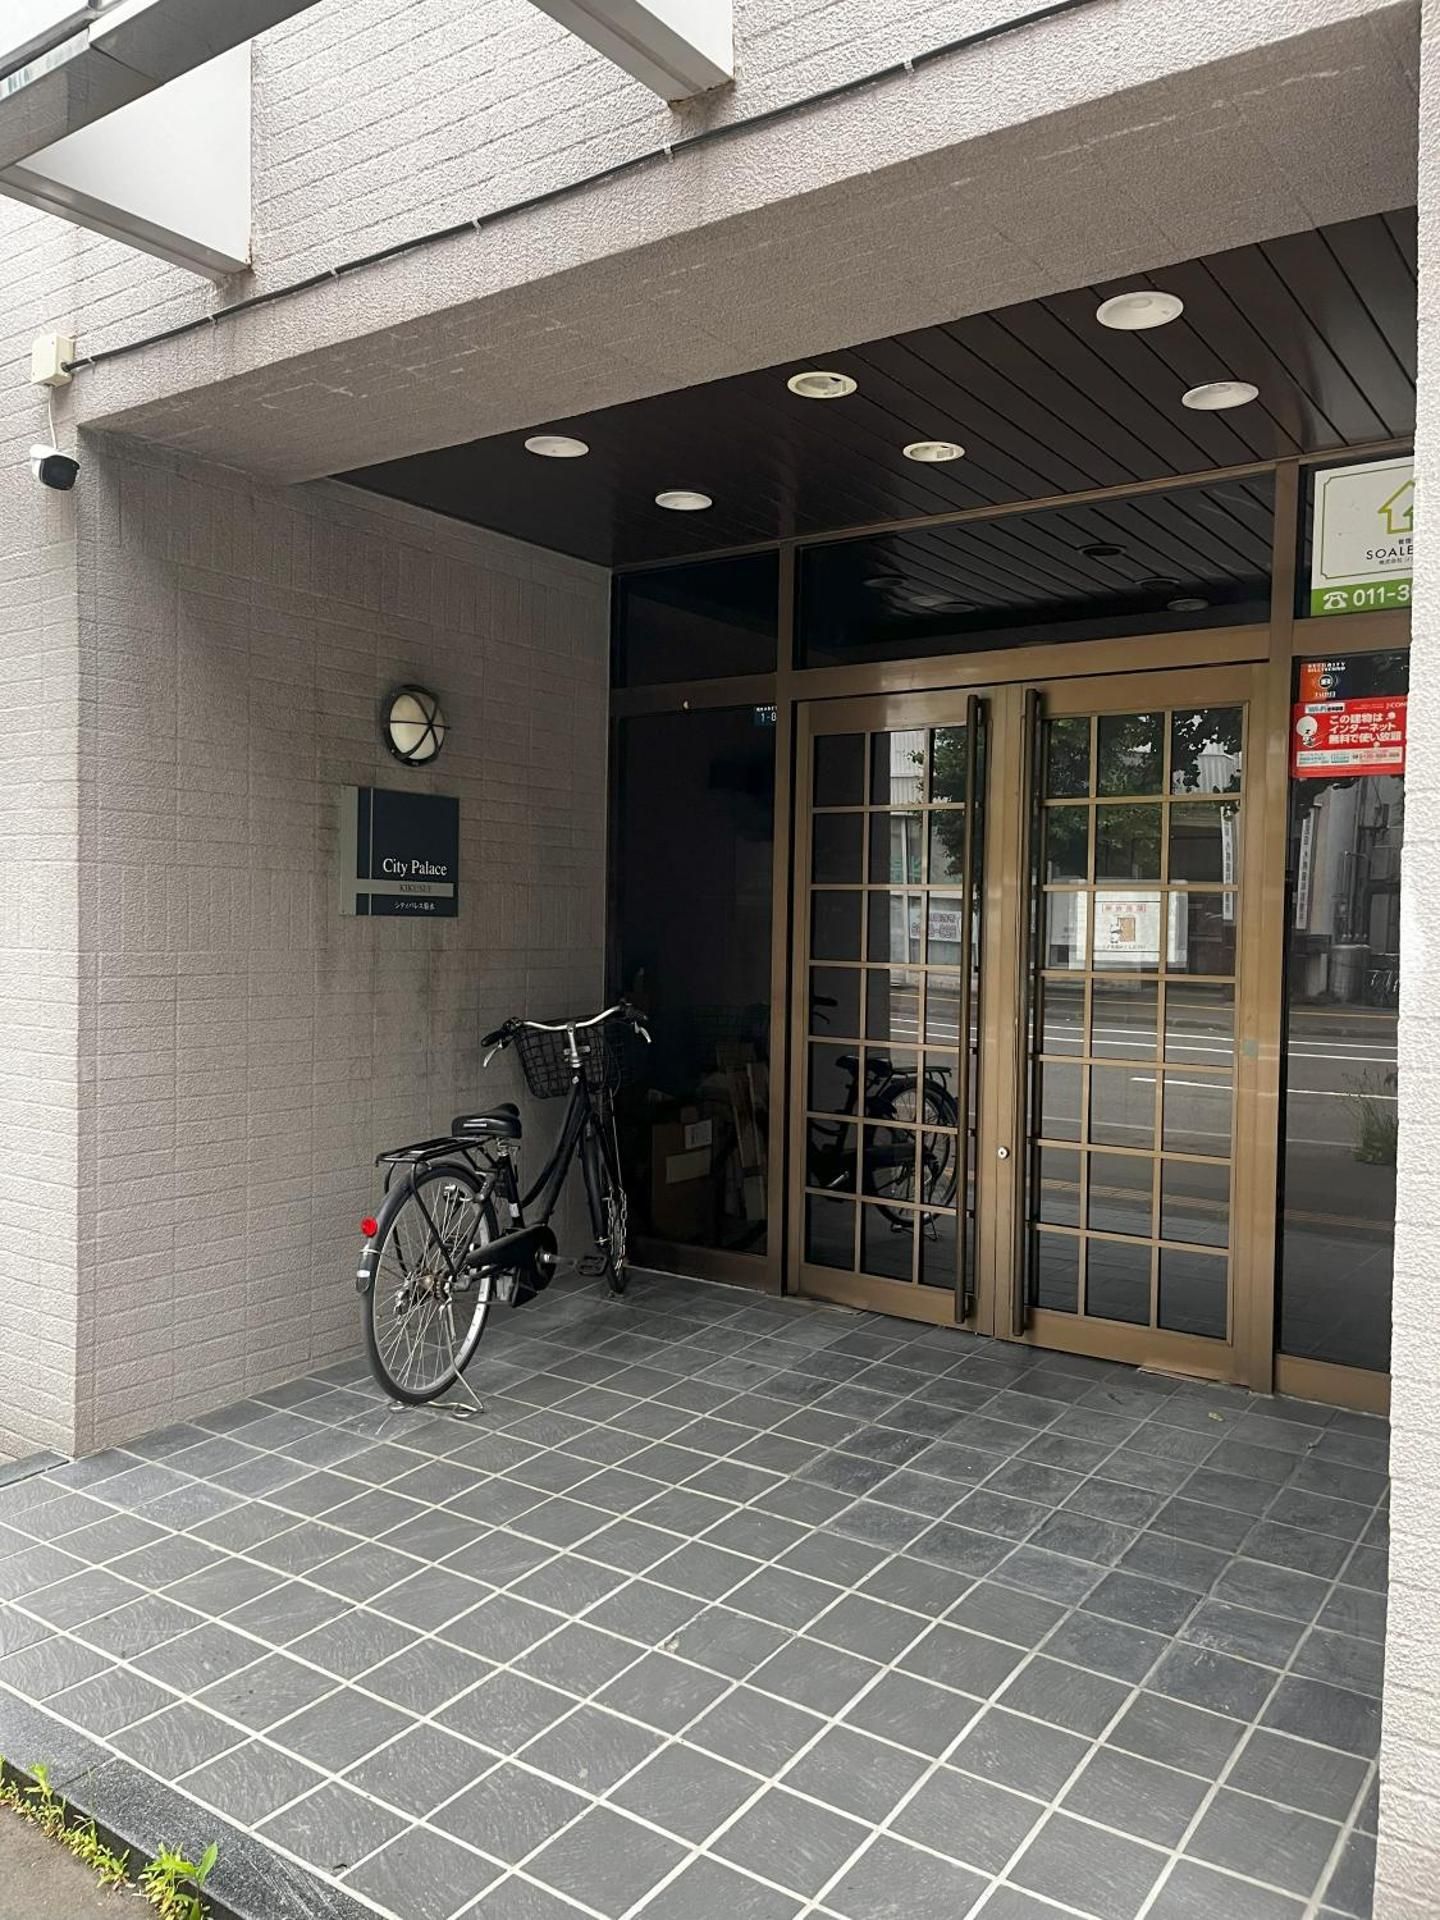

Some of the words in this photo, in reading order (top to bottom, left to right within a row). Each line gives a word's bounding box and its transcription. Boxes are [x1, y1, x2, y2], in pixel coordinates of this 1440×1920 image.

[1352, 584, 1410, 606] 011-3
[1329, 713, 1384, 724] この建物は
[1328, 722, 1397, 734] インターネット
[1328, 731, 1402, 744] 無料で使い放題
[382, 858, 408, 877] City
[411, 859, 448, 876] Palace
